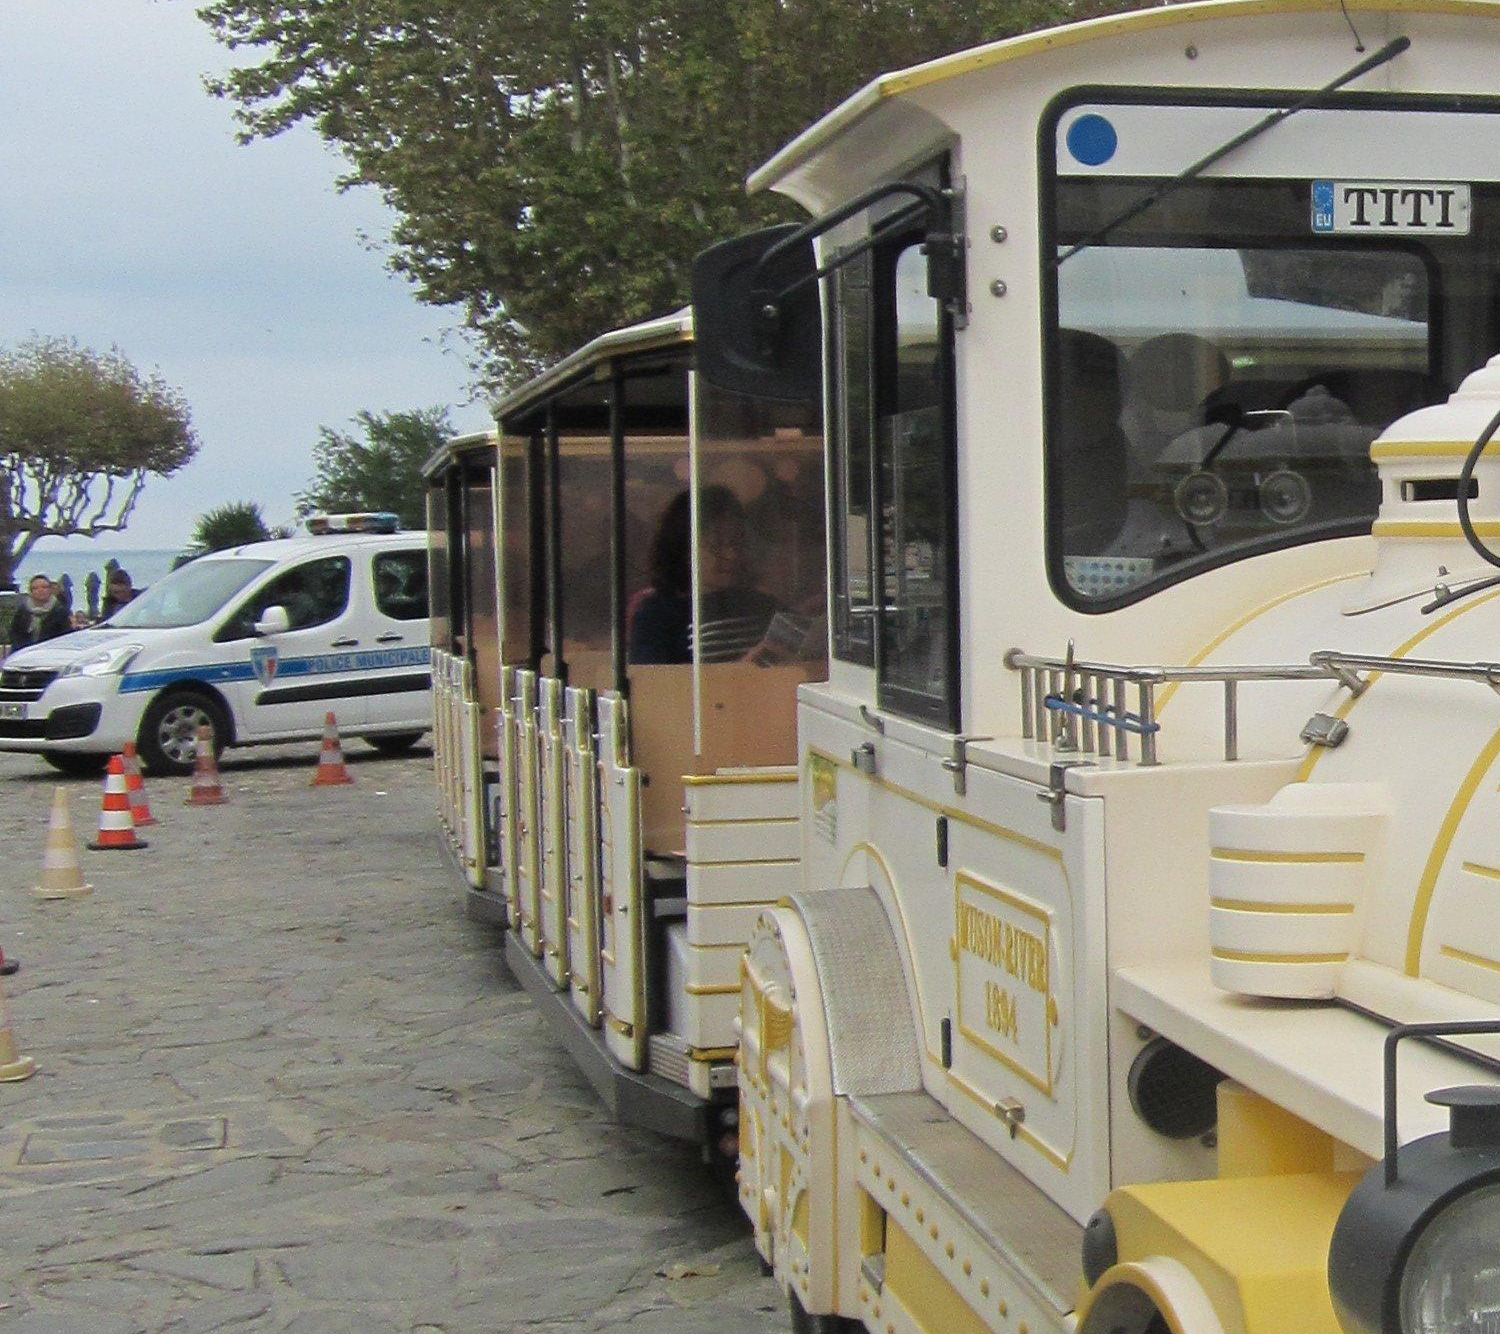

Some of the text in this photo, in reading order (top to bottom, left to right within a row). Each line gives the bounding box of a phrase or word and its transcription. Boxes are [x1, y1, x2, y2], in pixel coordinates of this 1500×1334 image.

[1344, 187, 1455, 227] TITI
[1316, 214, 1331, 226] EU
[307, 649, 430, 672] POLICE MUNICIPALE
